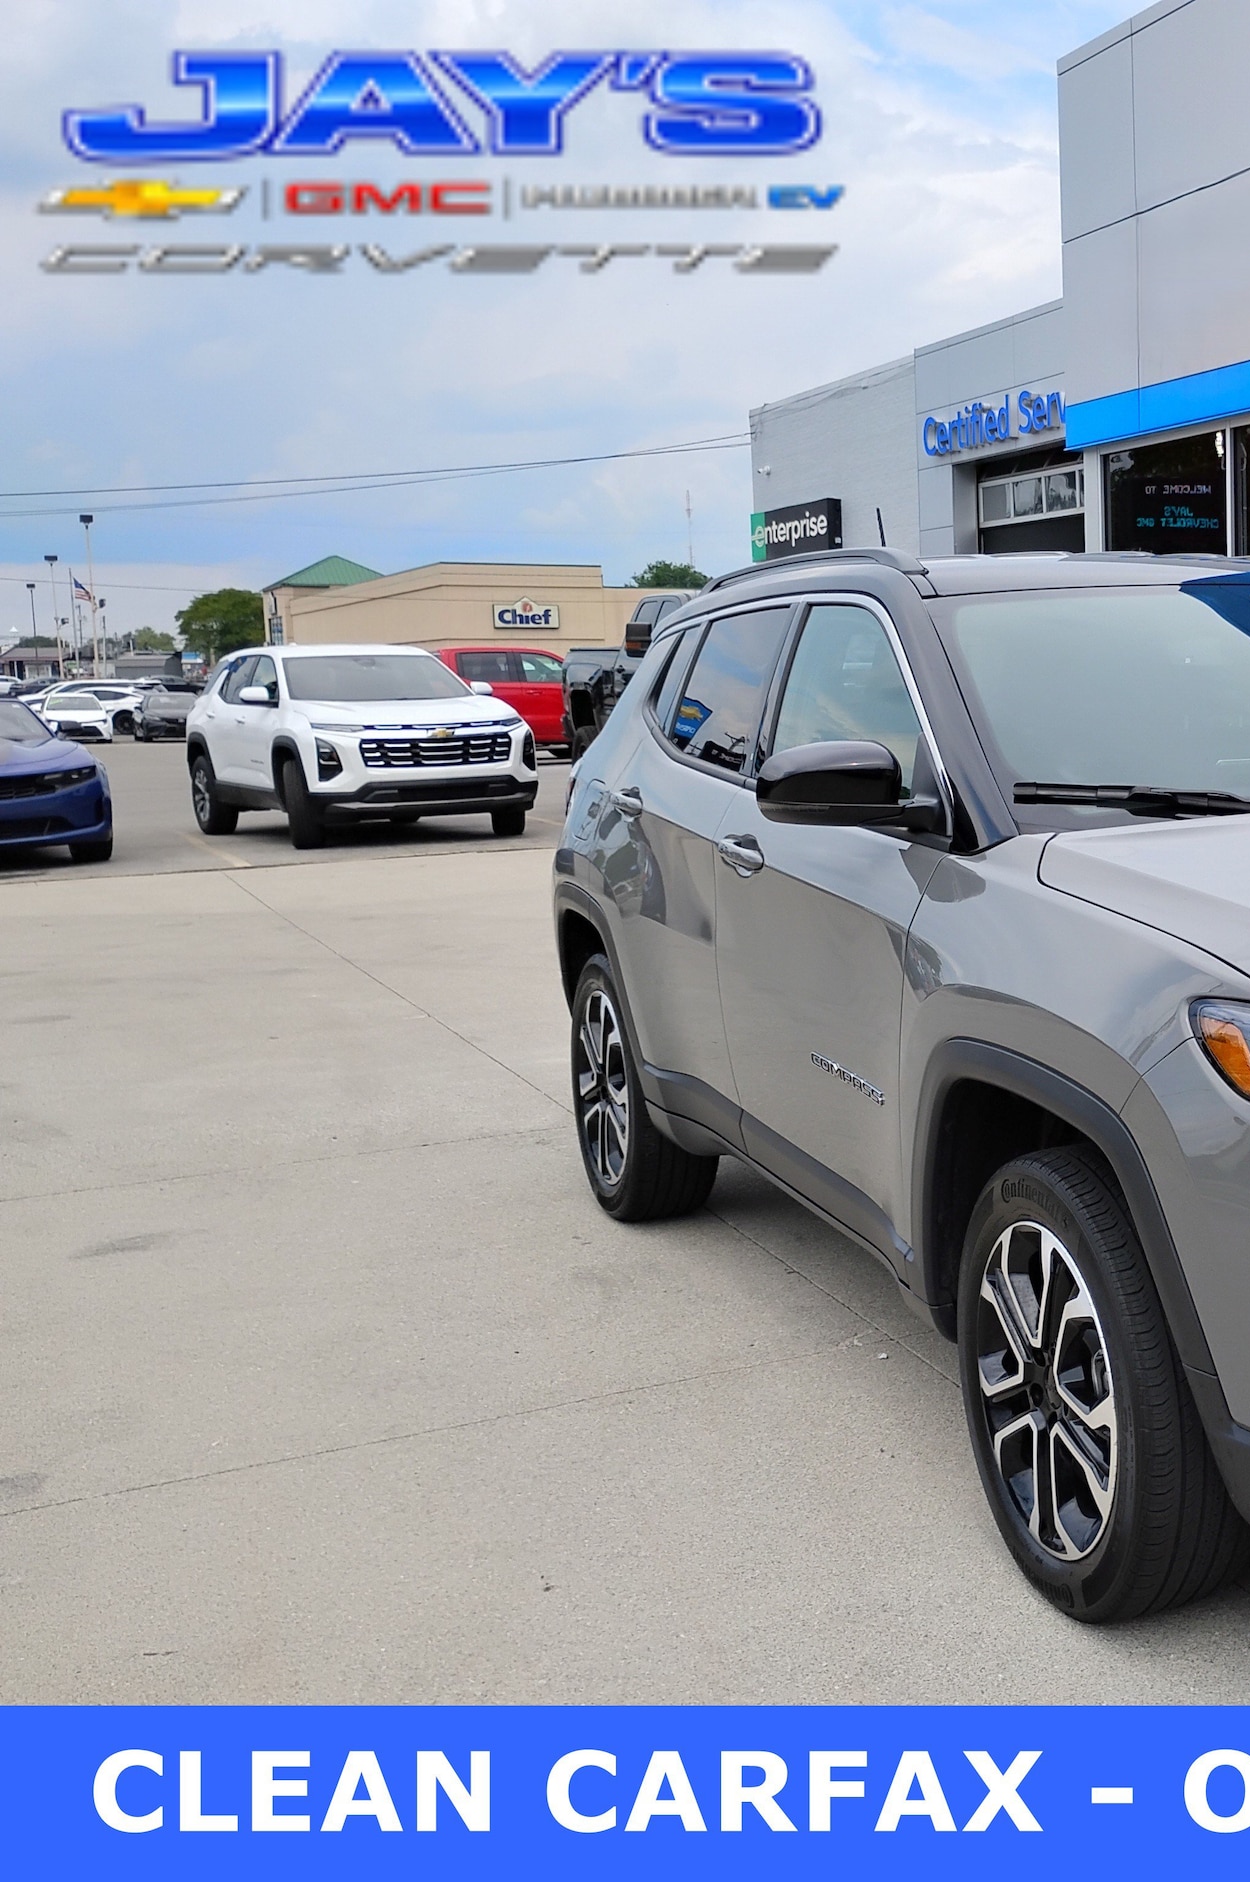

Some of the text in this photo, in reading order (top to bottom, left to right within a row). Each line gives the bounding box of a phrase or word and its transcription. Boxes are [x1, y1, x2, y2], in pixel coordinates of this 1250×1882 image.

[923, 393, 1010, 456] Certified
[752, 511, 828, 547] enterprise
[498, 608, 552, 625] Chief
[810, 1051, 885, 1106] COMPASS
